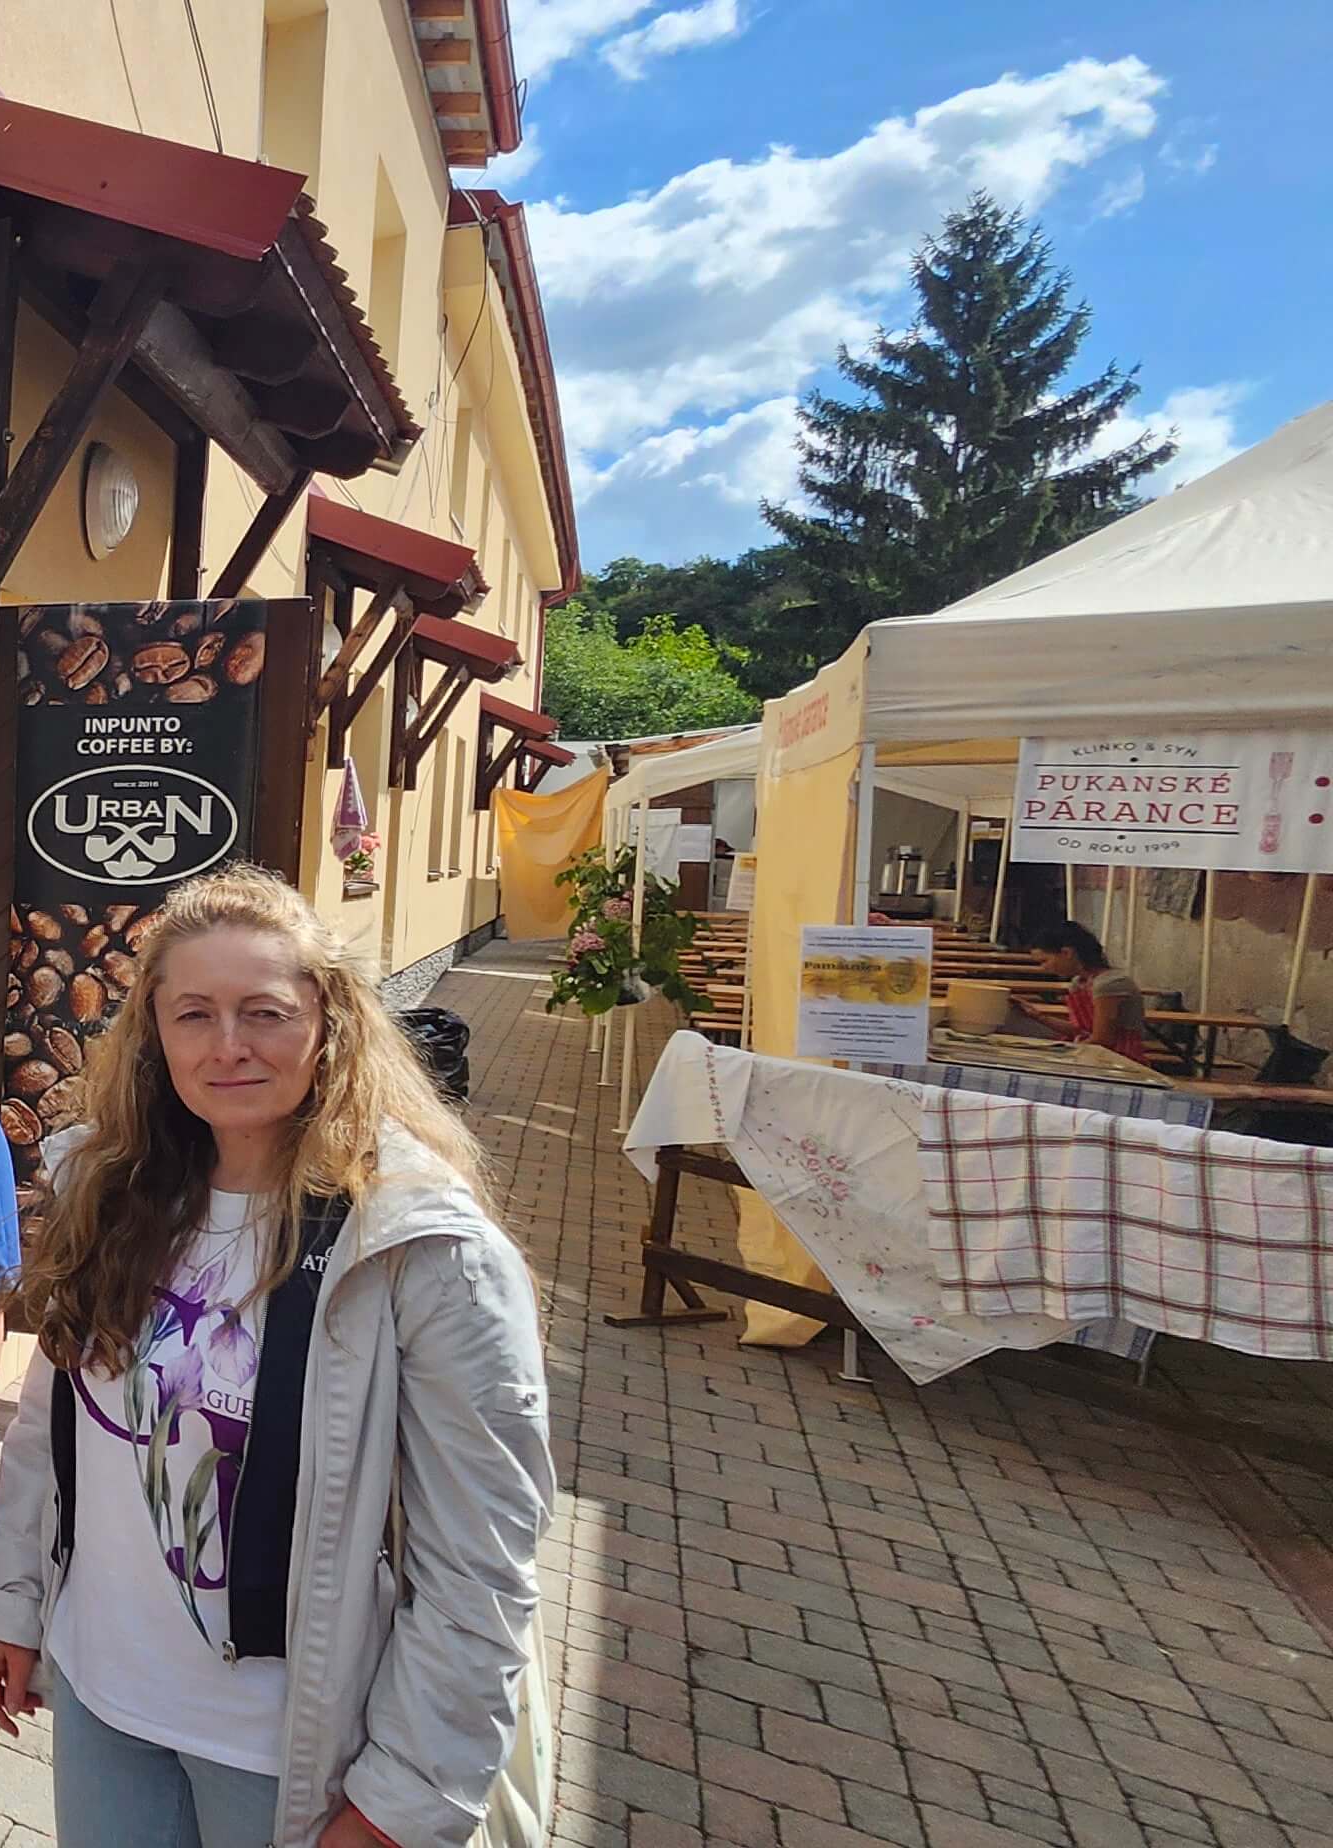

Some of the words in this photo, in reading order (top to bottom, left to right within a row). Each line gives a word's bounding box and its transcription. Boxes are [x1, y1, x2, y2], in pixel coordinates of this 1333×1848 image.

[84, 717, 182, 734] INPUNTO
[76, 738, 156, 755] COFFEE
[160, 738, 194, 754] BY:
[1071, 741, 1137, 757] KLINKO
[1163, 743, 1199, 758] SYN
[1037, 772, 1231, 794] PUKANSKÉ
[53, 794, 214, 835] URBAN
[1023, 795, 1241, 825] PÁRANCE
[1057, 837, 1082, 850] OD
[1088, 842, 1137, 854] ROKU
[1144, 839, 1182, 854] 1999
[206, 1388, 254, 1419] GUE
